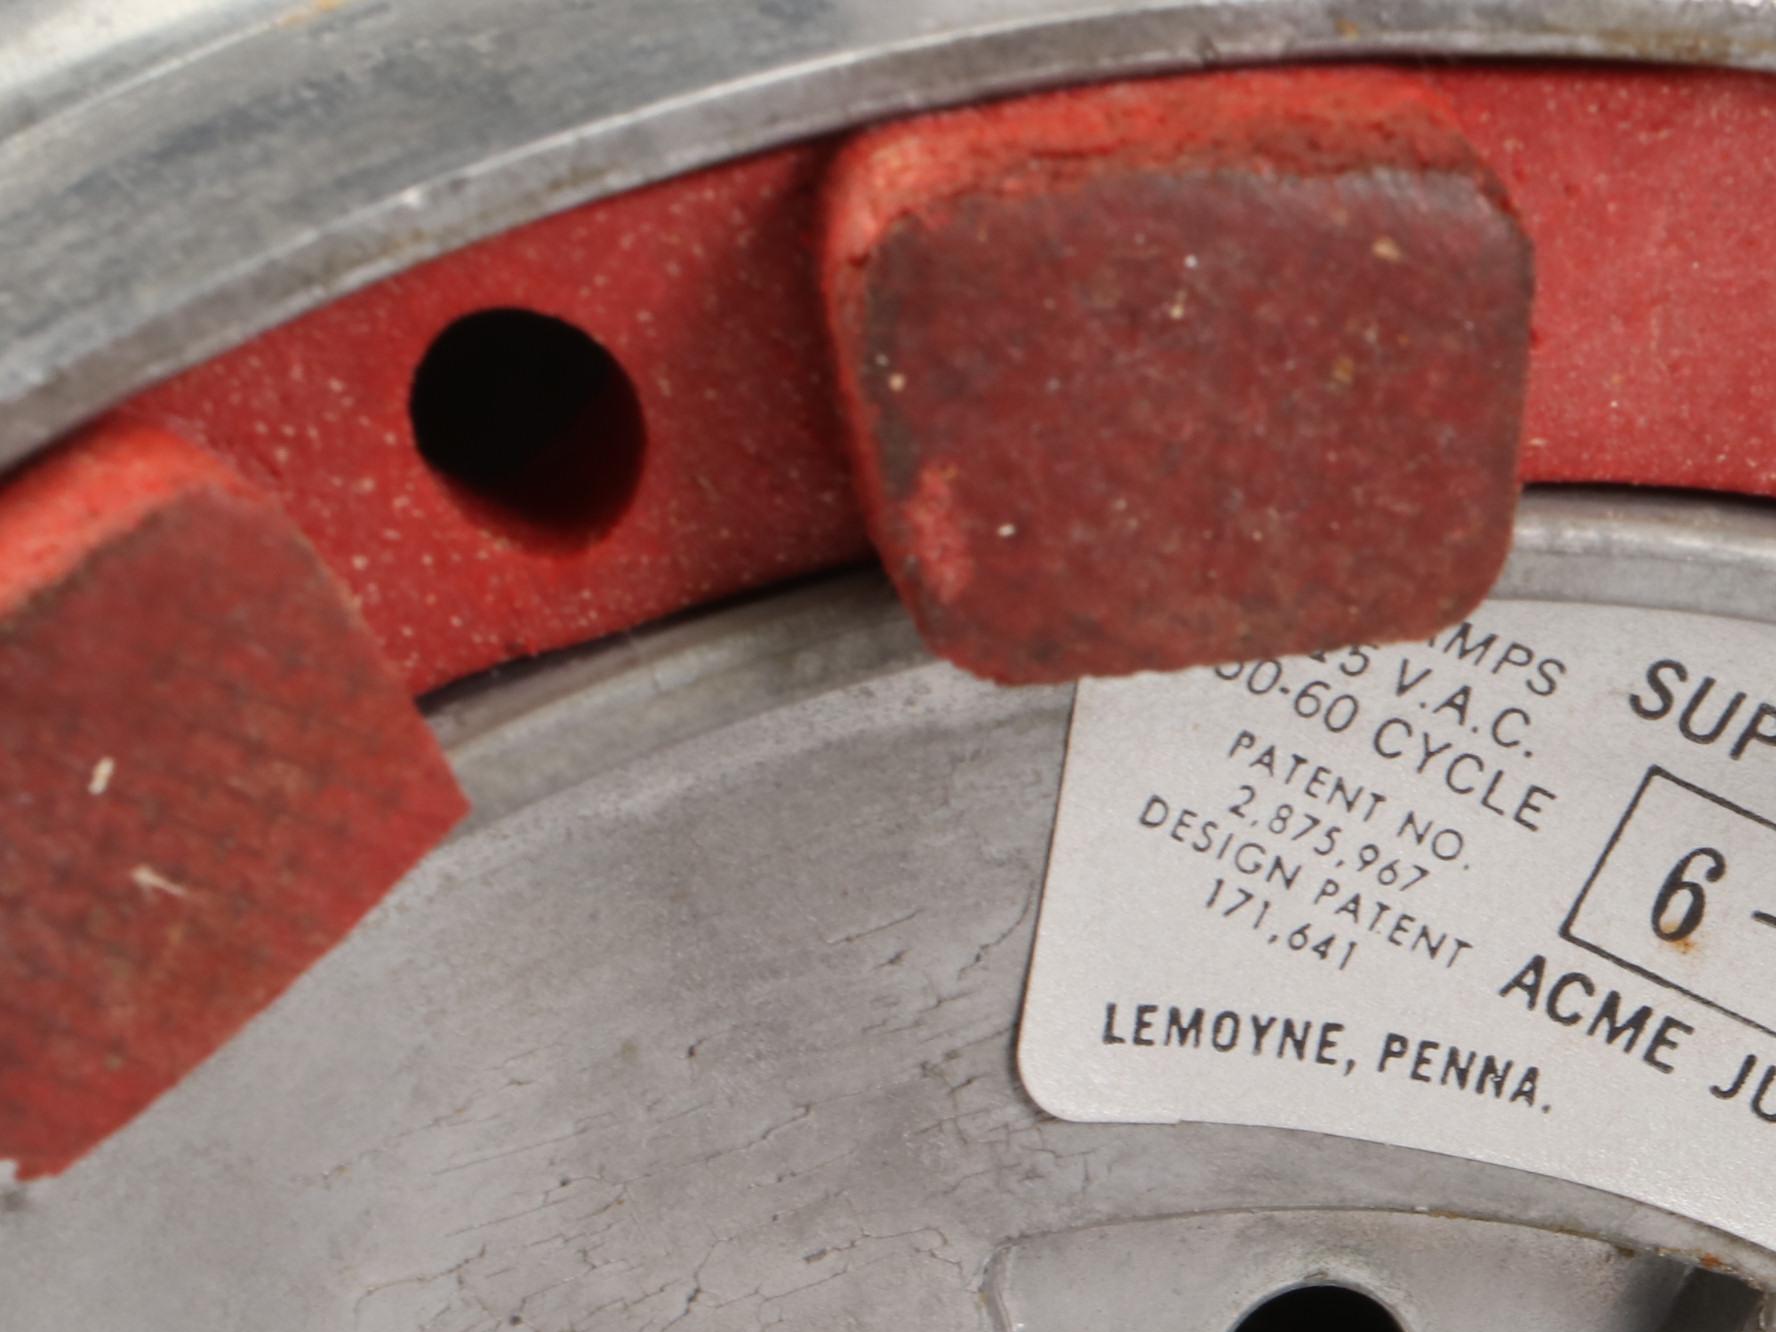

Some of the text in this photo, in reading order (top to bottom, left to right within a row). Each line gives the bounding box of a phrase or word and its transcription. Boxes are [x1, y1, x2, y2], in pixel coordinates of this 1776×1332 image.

[1395, 658, 1534, 759] V.A.C.
[1428, 621, 1567, 698] MPS
[1228, 730, 1471, 870] PATENT NO.
[1372, 717, 1557, 832] CYCLE
[1139, 794, 1473, 968] DESIGN PATENT
[1228, 784, 1430, 891] 2,875,967
[1206, 878, 1357, 970] 171,641
[1102, 1002, 1553, 1113] LEMOYNE, PENNA.
[1498, 954, 1695, 1075] ACME
